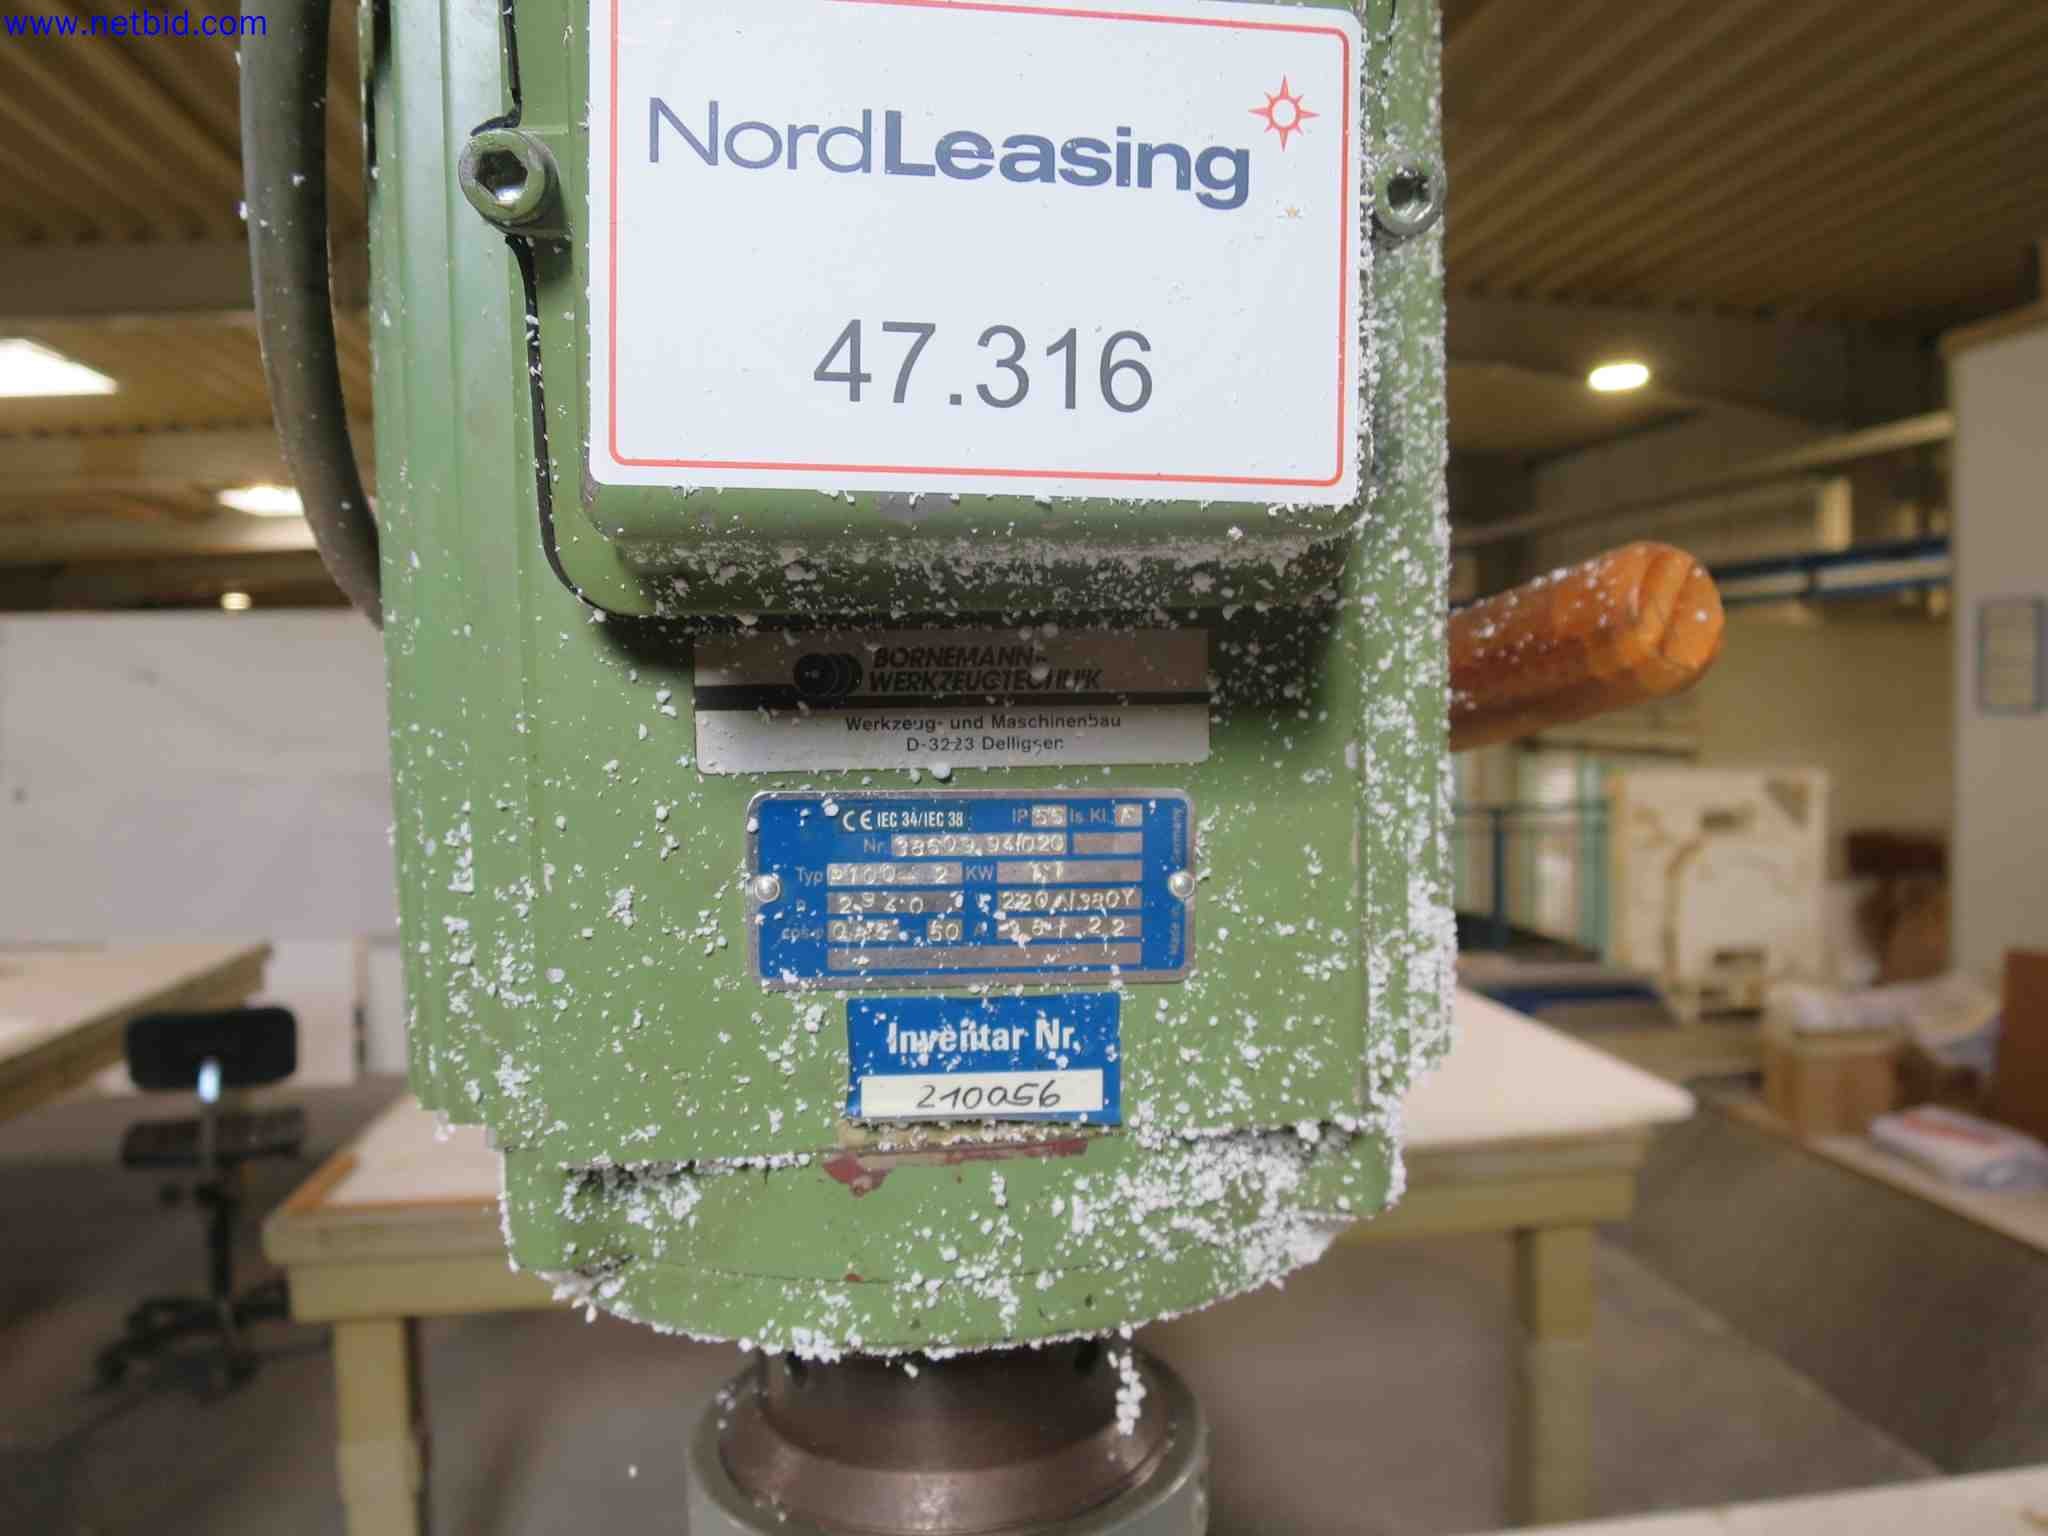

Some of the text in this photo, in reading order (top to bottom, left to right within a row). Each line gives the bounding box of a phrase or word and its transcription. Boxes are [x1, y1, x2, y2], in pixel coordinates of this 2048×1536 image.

[648, 97, 1251, 210] NordLeasing
[813, 319, 1154, 413] 47.316
[845, 713, 1121, 733] Werkzeug- und Maschinenbau
[877, 813, 898, 828] IEC
[901, 812, 945, 829] 34/IEC
[947, 810, 964, 828] 38
[795, 866, 823, 887] Typ
[965, 865, 995, 881] KW
[887, 1020, 1026, 1055] Inventar
